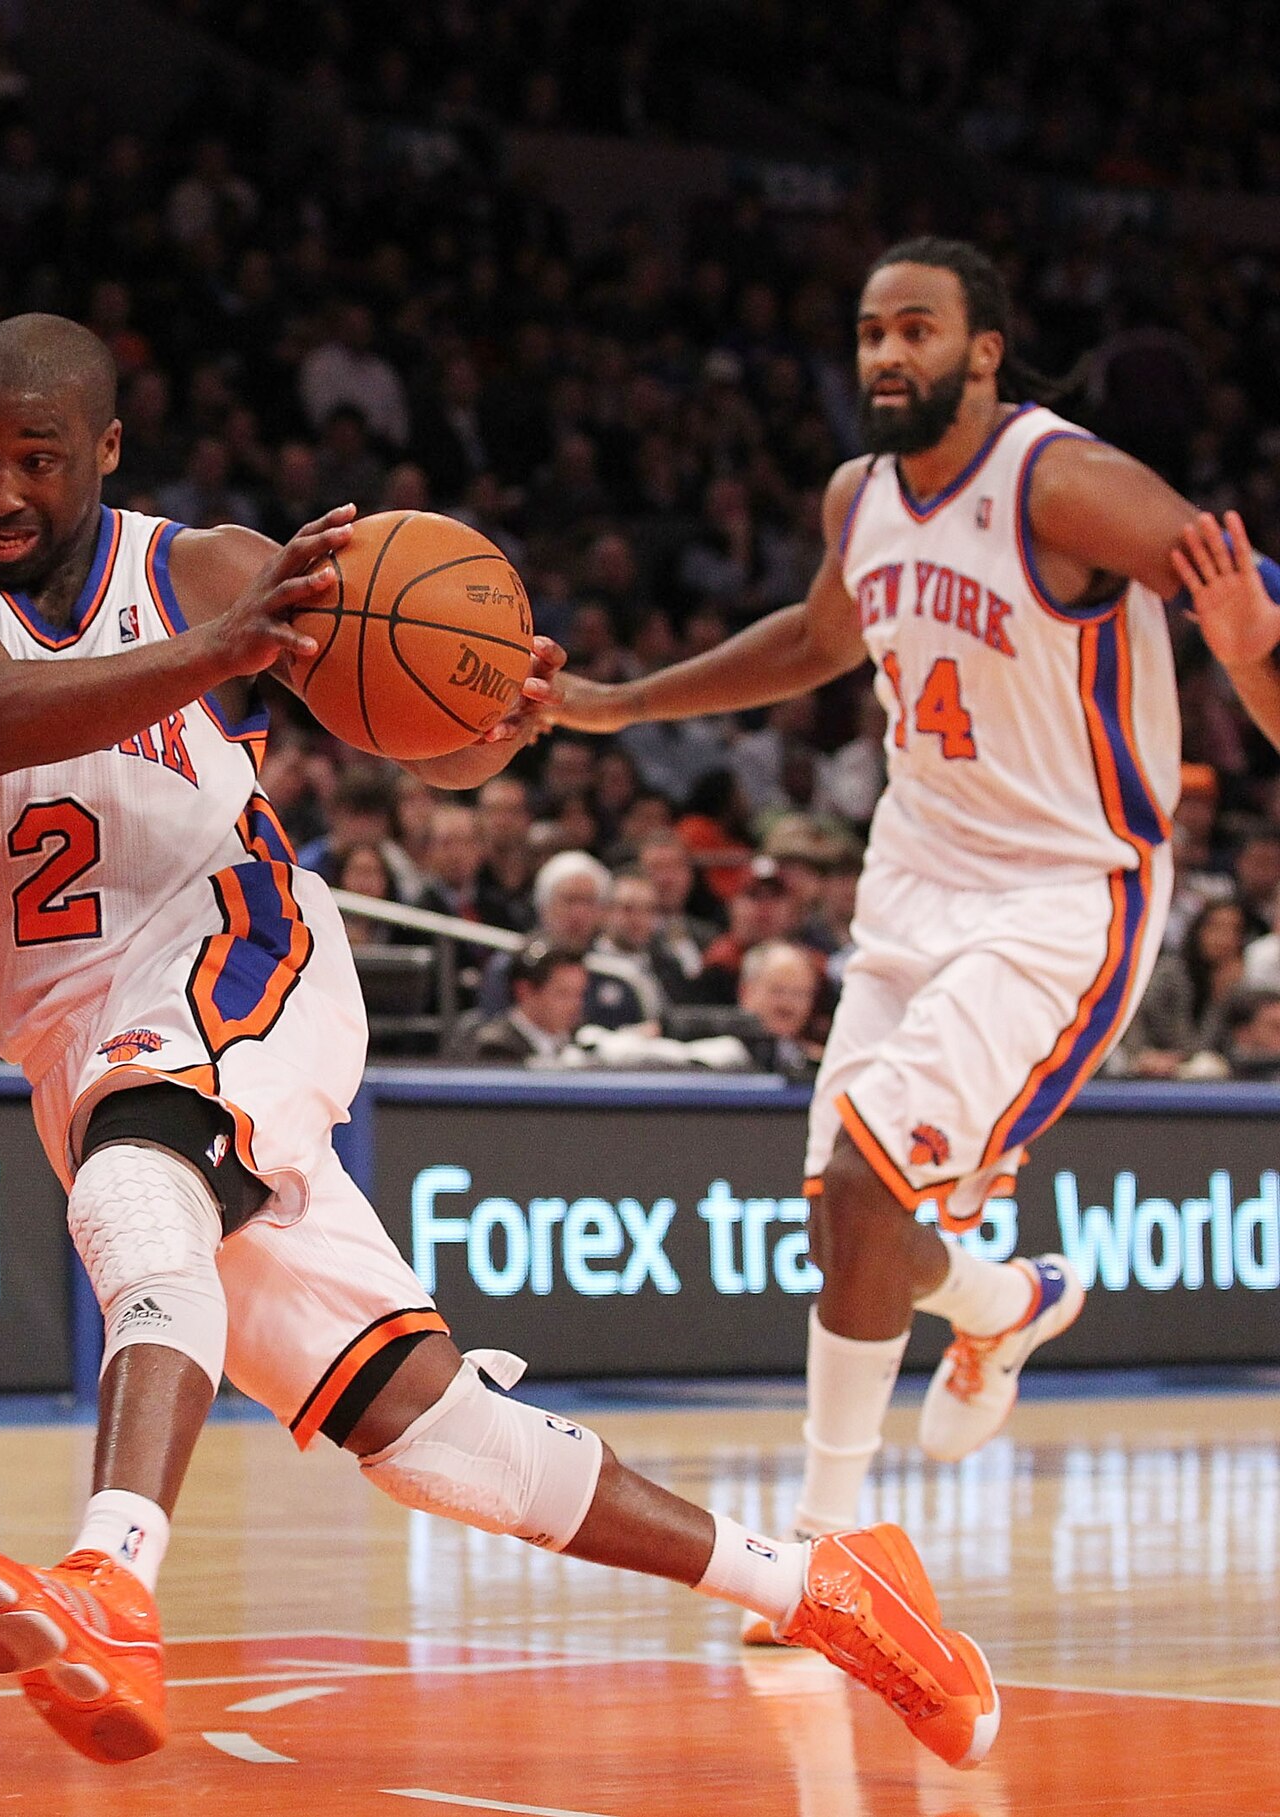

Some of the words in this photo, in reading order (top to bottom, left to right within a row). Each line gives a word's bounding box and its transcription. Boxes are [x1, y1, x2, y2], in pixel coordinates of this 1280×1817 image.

[915, 560, 1016, 659] YORK
[882, 650, 978, 761] 14
[7, 796, 102, 948] 2
[411, 1164, 683, 1297] Forex
[1054, 1168, 1280, 1291] World
